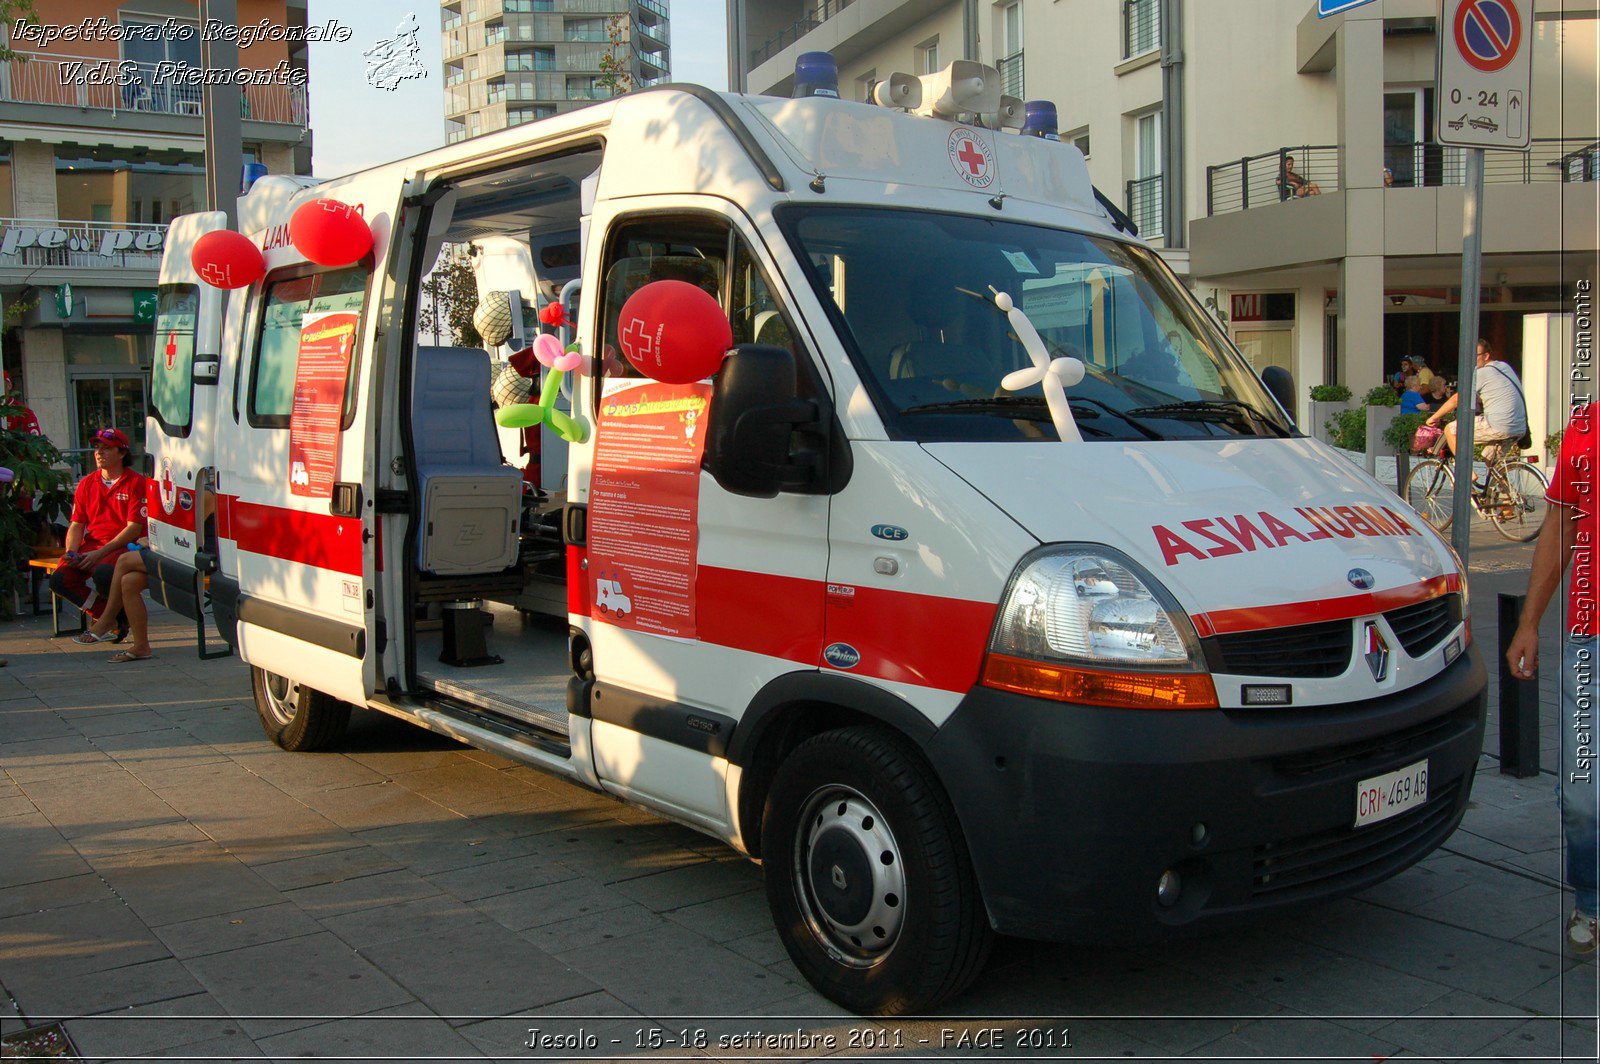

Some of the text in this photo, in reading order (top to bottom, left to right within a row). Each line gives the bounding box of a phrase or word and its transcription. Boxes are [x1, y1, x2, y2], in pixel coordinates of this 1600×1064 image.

[1451, 88, 1461, 104] 0
[1478, 90, 1498, 107] 24
[961, 170, 991, 186] TRENTO
[655, 322, 665, 345] ROSSA
